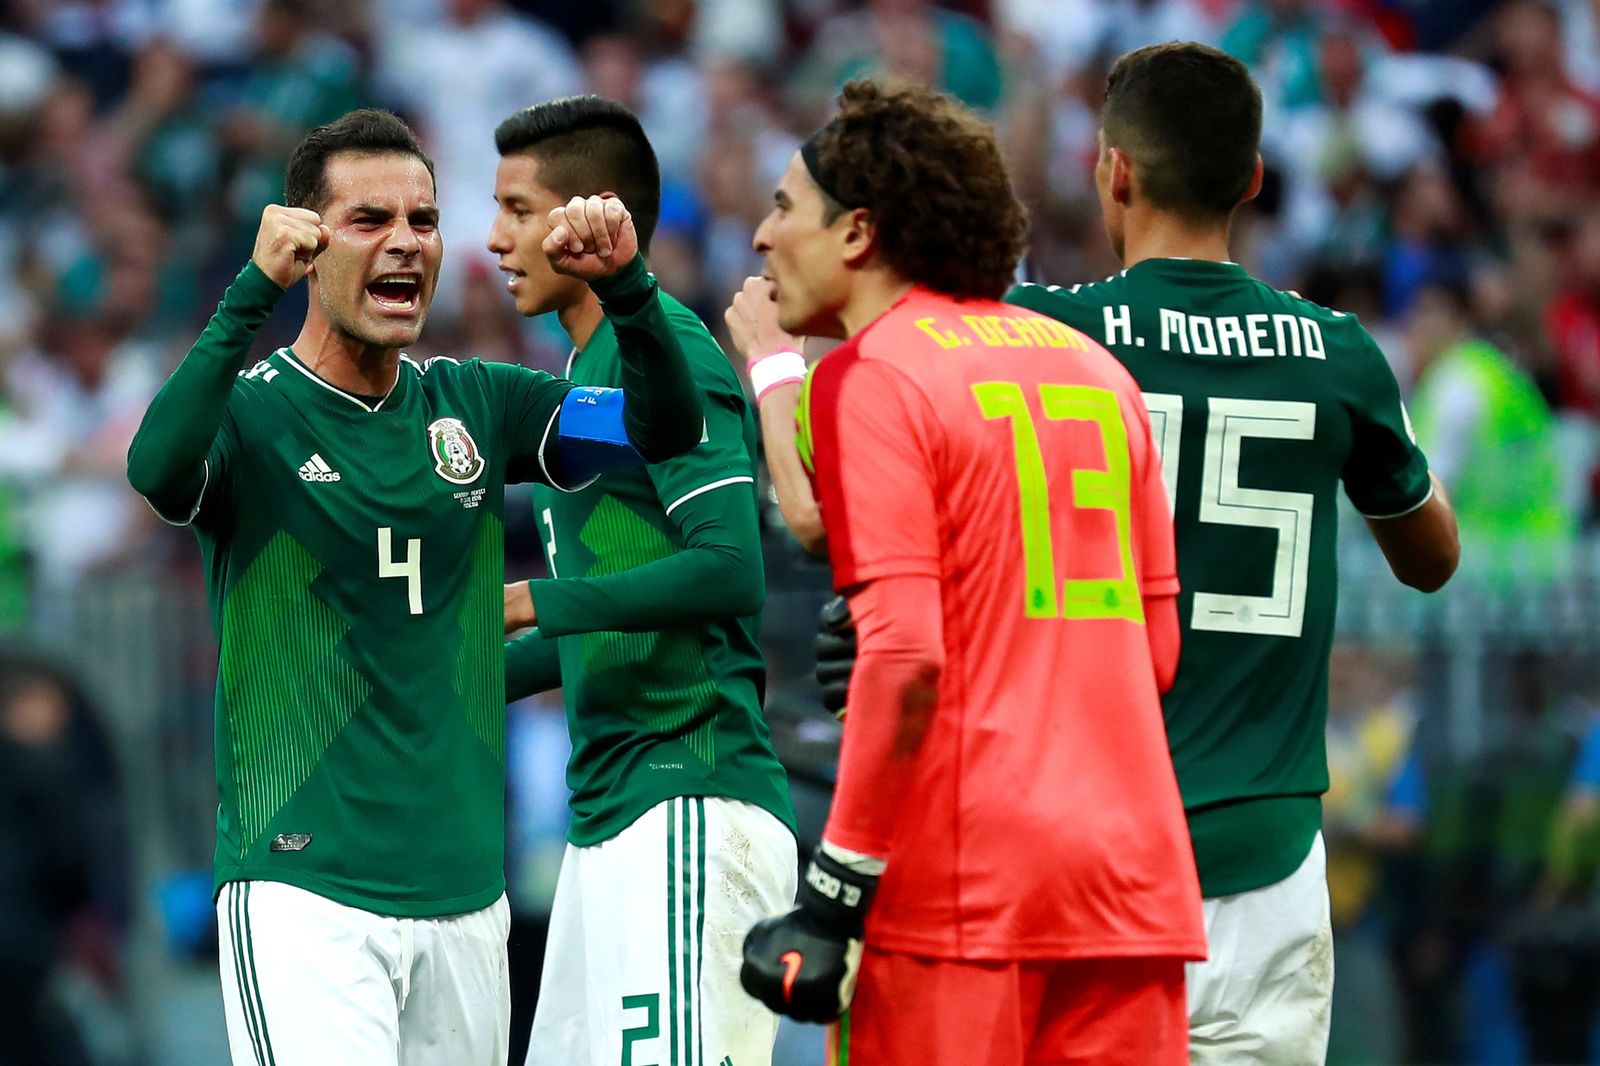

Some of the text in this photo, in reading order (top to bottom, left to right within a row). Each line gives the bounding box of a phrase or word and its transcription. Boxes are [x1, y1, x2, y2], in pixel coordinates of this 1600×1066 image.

[1103, 305, 1327, 360] H. MORENO
[298, 471, 341, 482] adidas
[970, 381, 1146, 625] 13
[377, 527, 423, 615] 4
[621, 992, 660, 1066] 2
